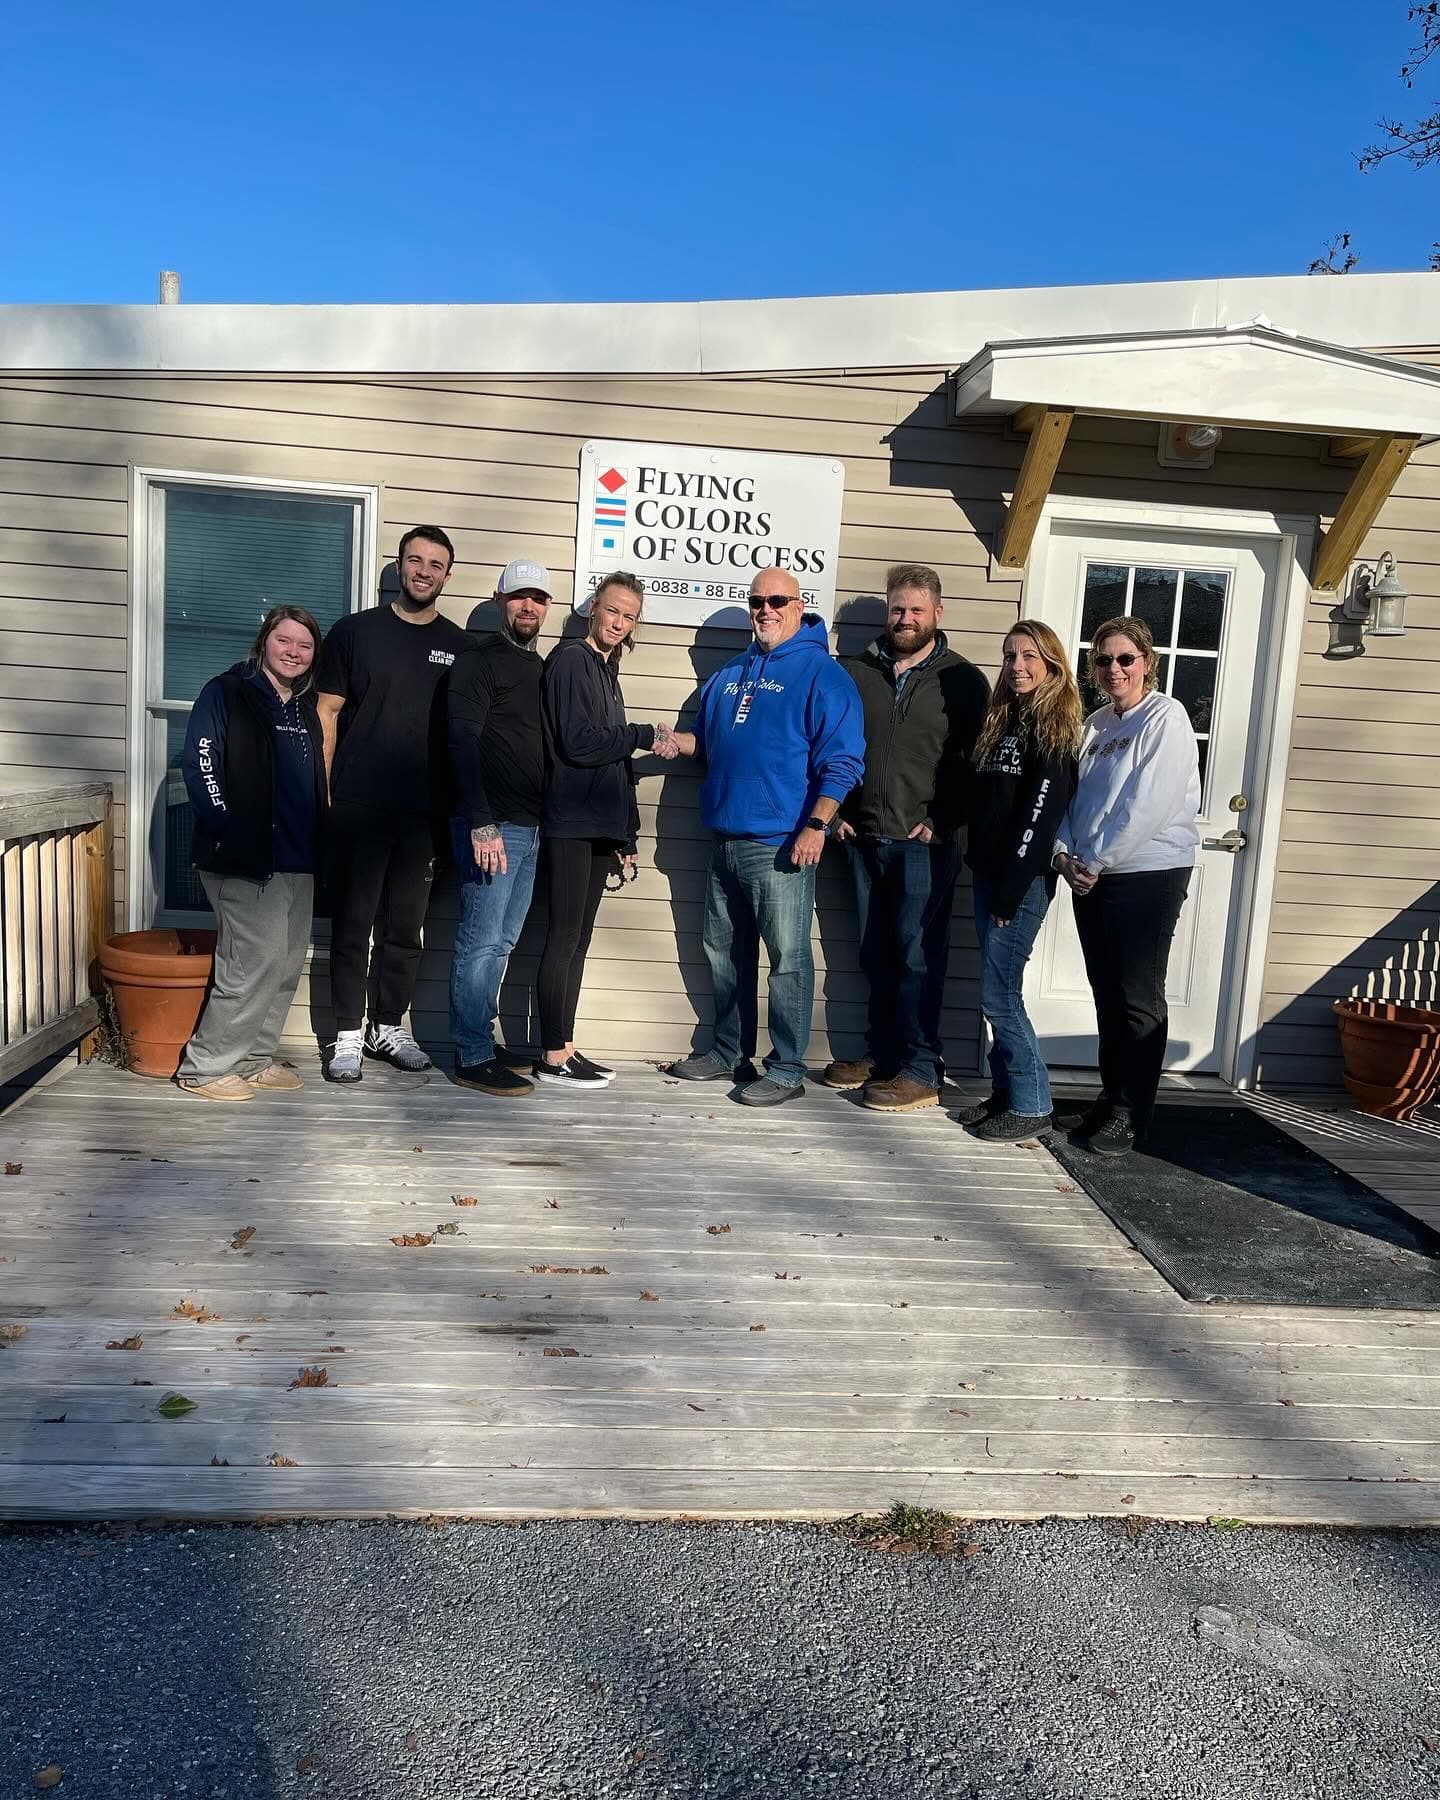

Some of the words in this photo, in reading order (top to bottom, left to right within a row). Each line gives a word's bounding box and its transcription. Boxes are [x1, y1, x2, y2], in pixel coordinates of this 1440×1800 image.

[636, 466, 755, 503] FLYING
[635, 500, 771, 537] COLORS
[633, 535, 677, 561] OF
[684, 537, 825, 574] SUCCESS
[705, 584, 724, 598] 88
[728, 586, 752, 600] Eas
[1031, 778, 1051, 823] EST
[1017, 828, 1035, 858] 04
